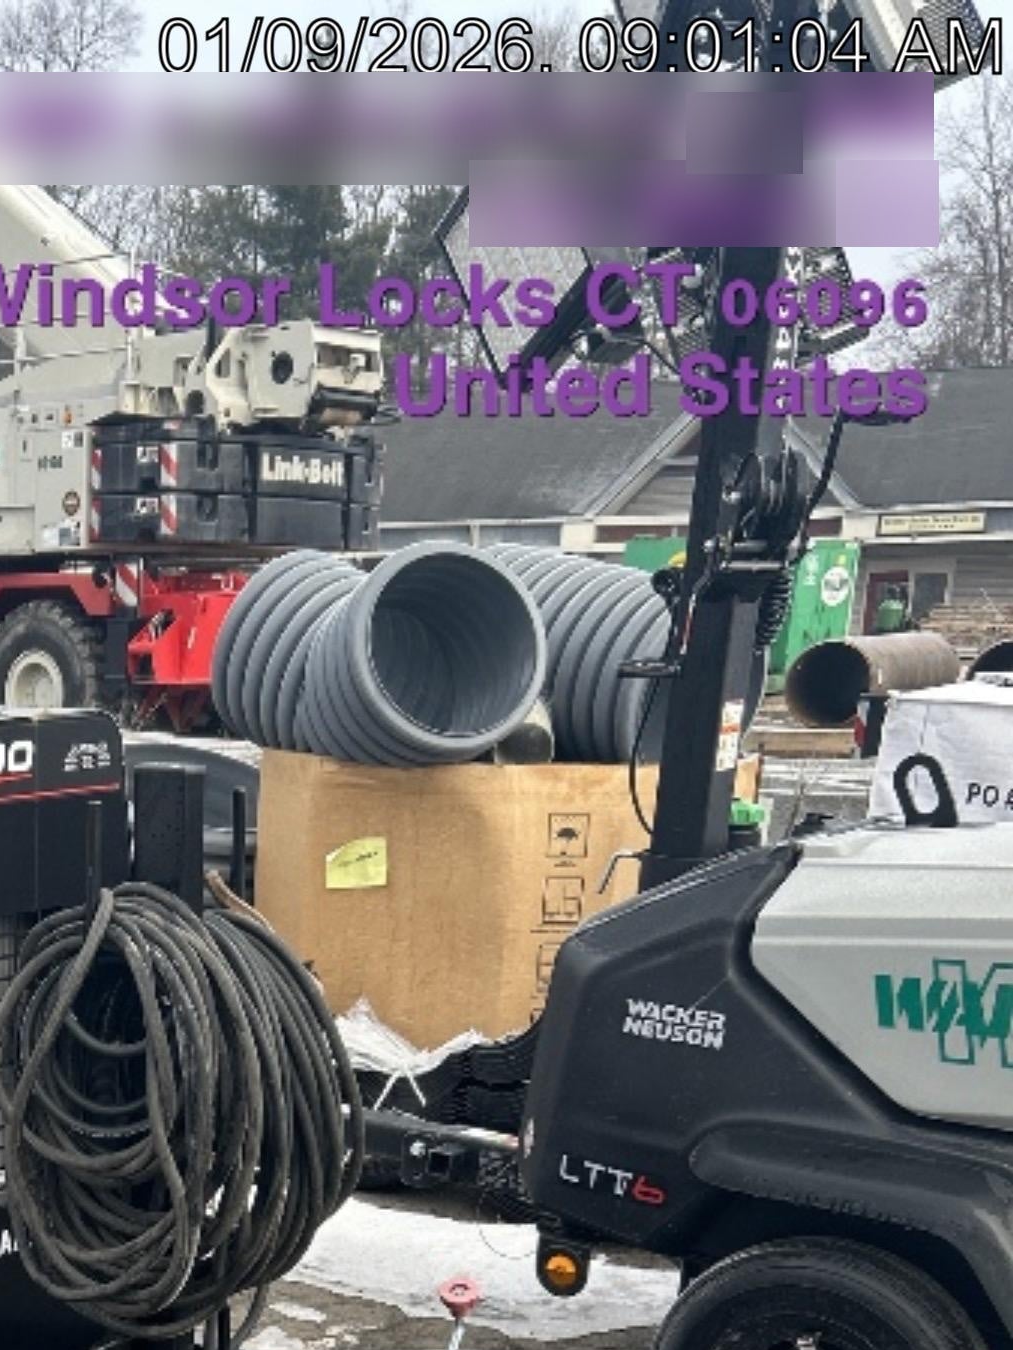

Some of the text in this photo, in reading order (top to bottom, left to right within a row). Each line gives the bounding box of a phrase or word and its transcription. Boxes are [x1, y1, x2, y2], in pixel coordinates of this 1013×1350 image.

[261, 453, 344, 487] Link-Belt
[966, 782, 999, 807] PO
[627, 998, 725, 1029] WACKER
[623, 1016, 725, 1050] NEUSON
[559, 1154, 663, 1204] LTT6
